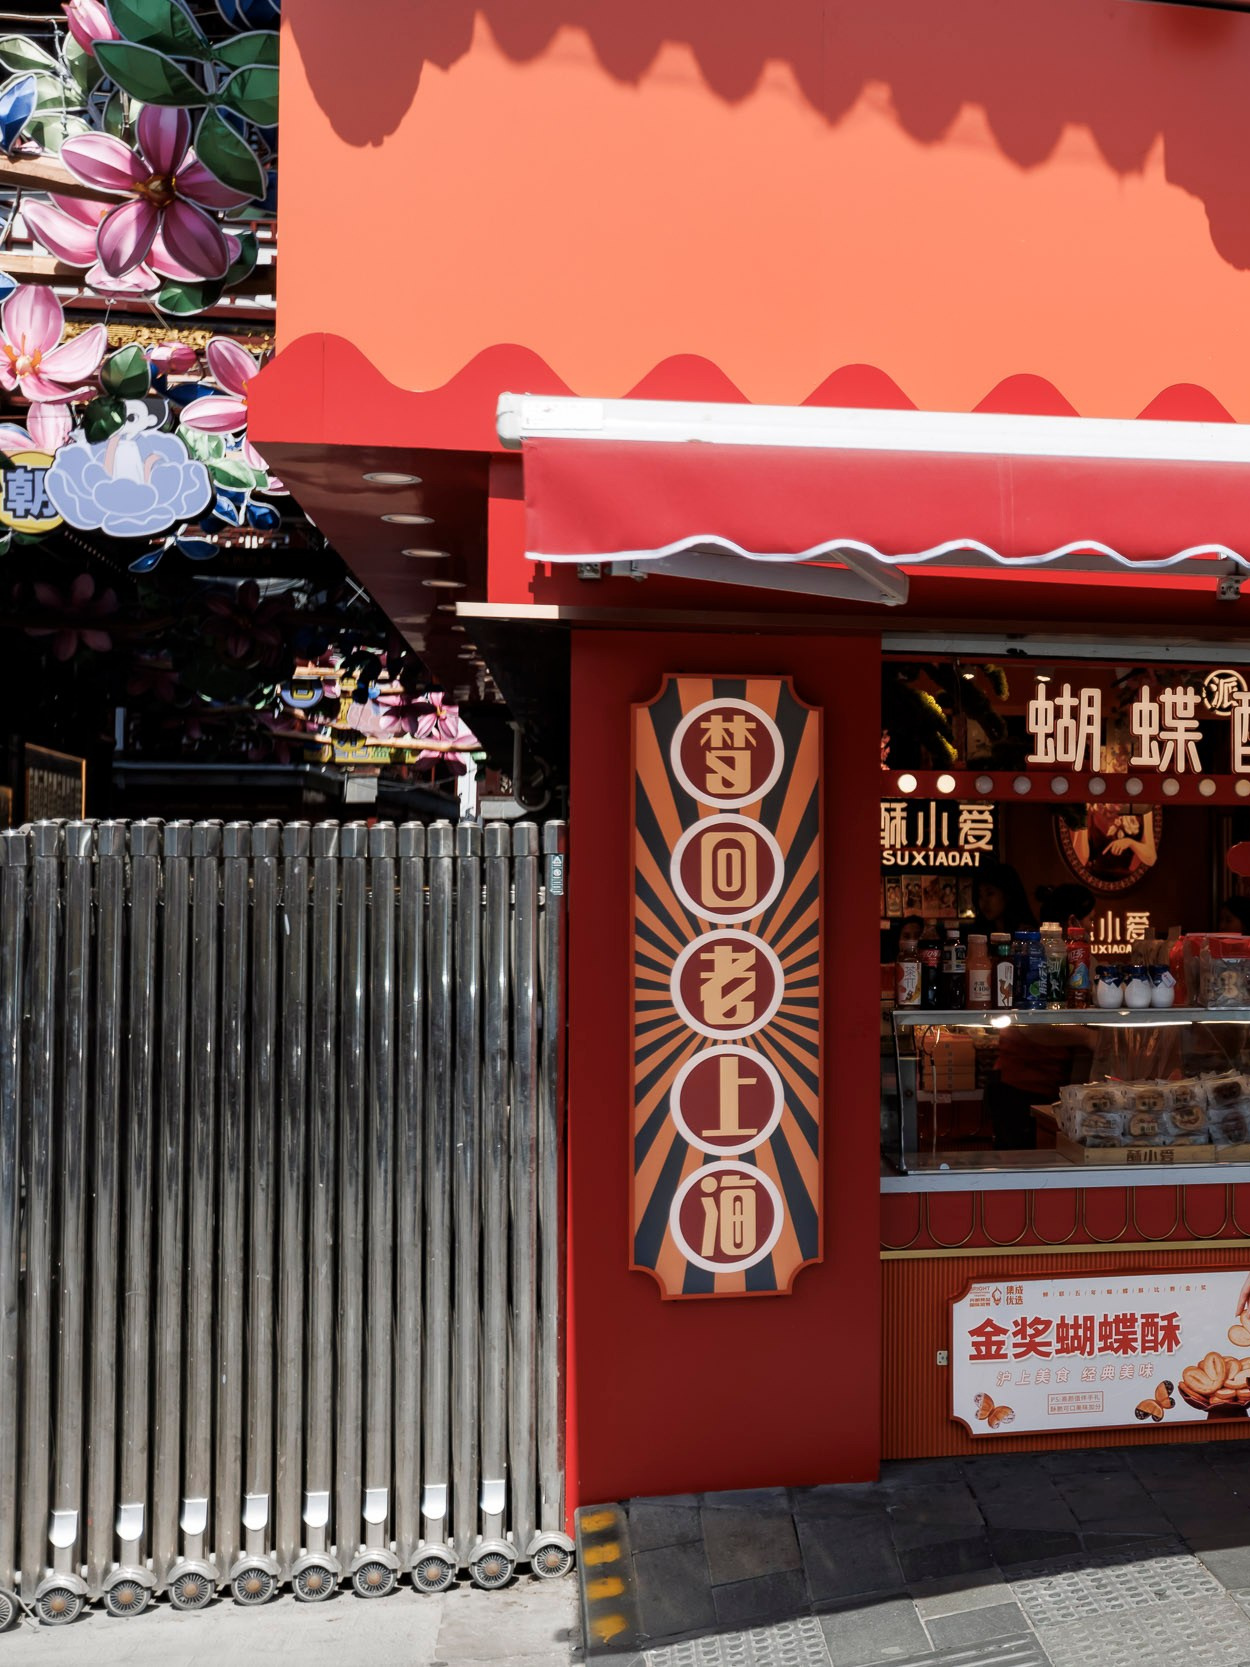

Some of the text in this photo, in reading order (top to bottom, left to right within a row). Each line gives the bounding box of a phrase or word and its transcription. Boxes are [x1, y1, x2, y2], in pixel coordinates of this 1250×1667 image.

[881, 850, 980, 867] SUXIAOAI
[1090, 911, 1150, 943] 小爱
[700, 714, 758, 1258] 梦回老上海
[968, 1311, 1182, 1361] 金奖蝴蝶酥
[996, 1363, 1154, 1387] 沪上美食 经典美味
